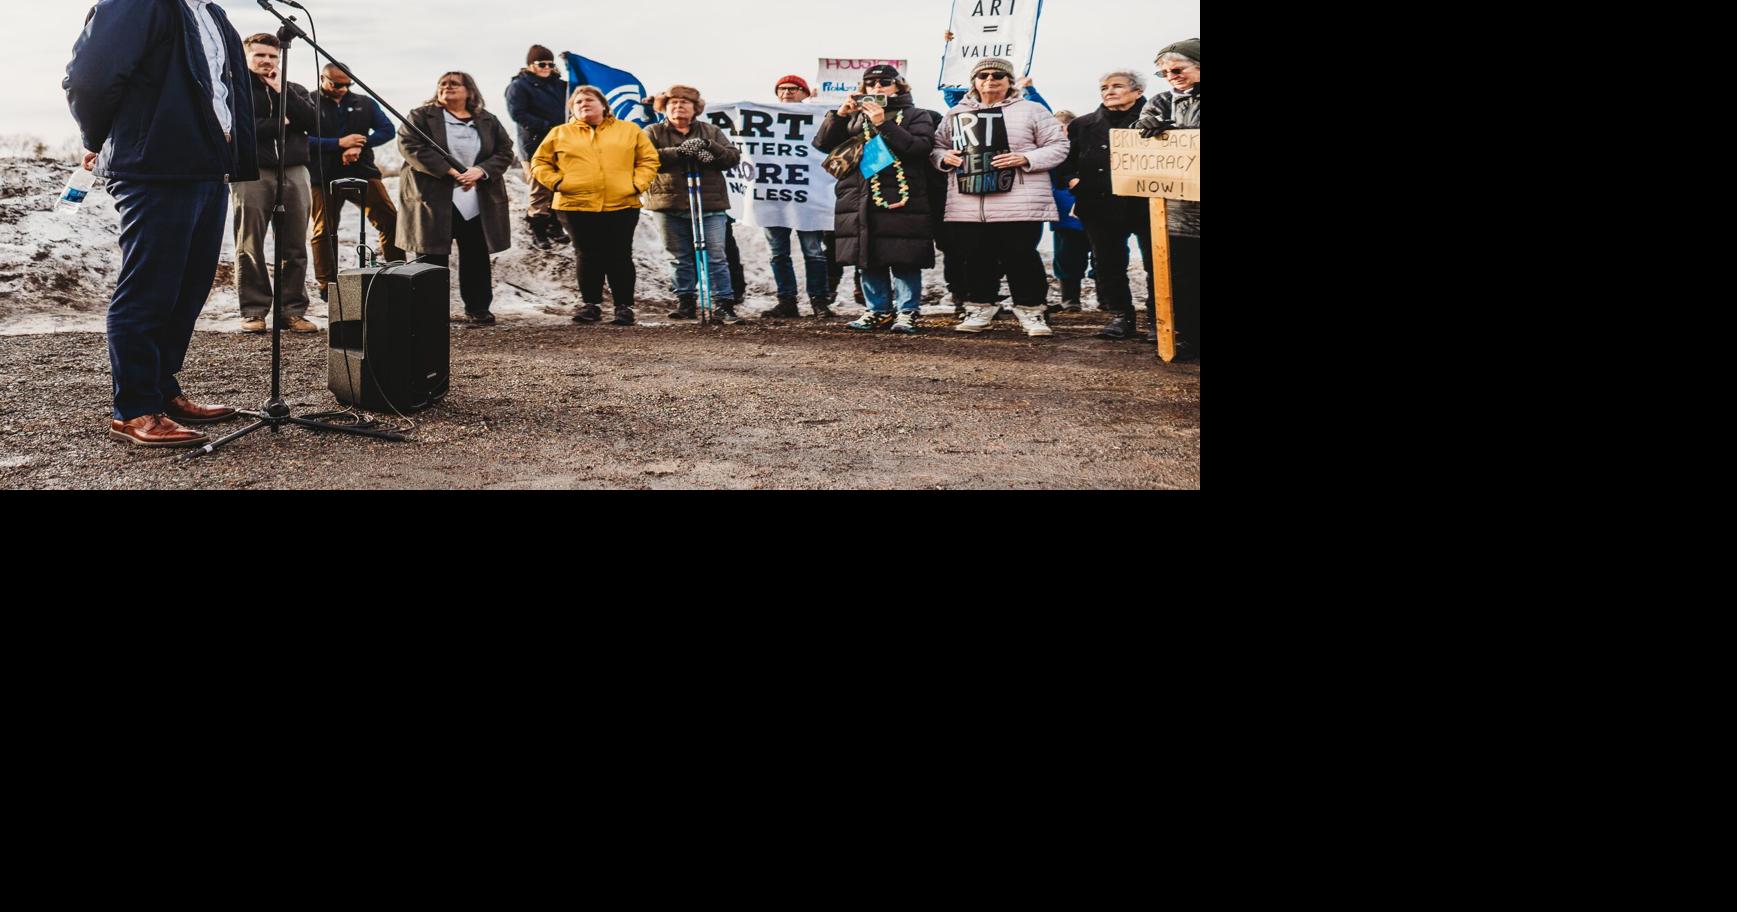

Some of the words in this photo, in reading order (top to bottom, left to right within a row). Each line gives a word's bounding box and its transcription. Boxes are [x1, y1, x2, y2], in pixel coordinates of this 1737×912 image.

[962, 44, 1013, 58] VALUE
[706, 109, 814, 141] ART
[952, 112, 1002, 150] ART
[732, 141, 809, 157] TTERS
[1111, 151, 1197, 171] DEMOCRACY
[959, 170, 1012, 193] THING
[753, 188, 809, 203] LESS
